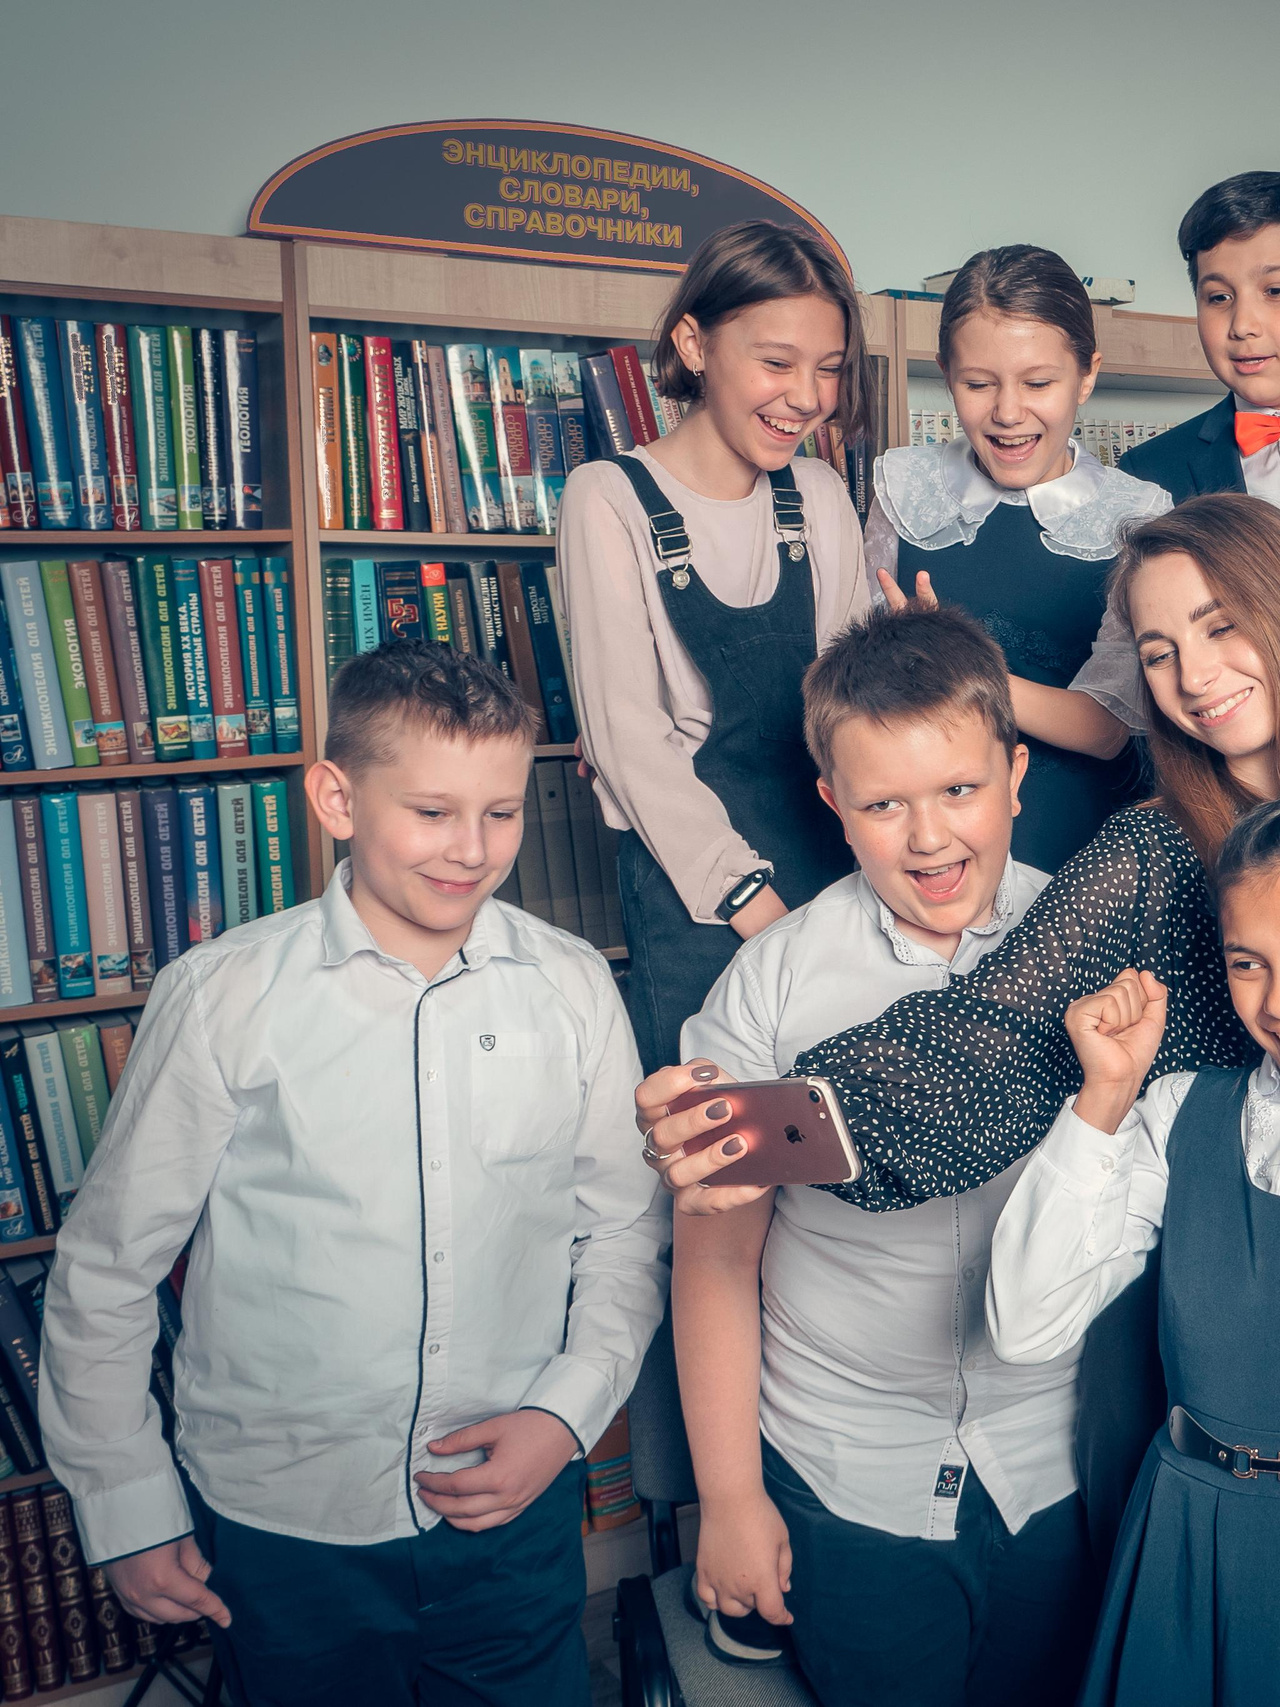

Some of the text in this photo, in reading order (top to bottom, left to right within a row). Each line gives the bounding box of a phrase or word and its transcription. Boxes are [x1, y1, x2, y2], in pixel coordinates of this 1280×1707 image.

[441, 138, 699, 198] ЭНЦИКЛОПЕДИИ,
[498, 176, 650, 219] СЛОВАРИ,
[462, 203, 683, 249] СПРАВОЧНИКИ
[150, 334, 169, 481] ЭНЦИКЛОПЕДИЯ ДЛЯ ДЕТЕЙ
[183, 384, 197, 454] ЭКОЛОГИЯ
[238, 387, 251, 453] ГЕОЛОГИЯ
[393, 356, 409, 430] МИР ЖИВОТНЫХ
[374, 364, 396, 501] ВЕТЕРИНАРИЯ
[243, 589, 253, 614] ДЕТЕЙ
[247, 616, 255, 632] ДЛЯ
[273, 588, 283, 612] ДЕТЕЙ
[276, 615, 285, 631] ДЛЯ
[361, 584, 373, 621] ИМЁН
[432, 592, 448, 631] НАУКИ
[480, 577, 497, 651] ЭНЦИКЛОПЕДИЯ
[489, 577, 503, 637] ФАНТАСТИКИ
[16, 577, 57, 755] ЭНЦИКЛОПЕДИЯ ДЛЯ ДЕТЕЙ
[64, 618, 86, 689] ЭКОЛОГИЯ
[79, 569, 112, 716] ЭНЦИКЛОПЕДИЯ ДЛЯ ДЕТЕЙ
[118, 569, 149, 716] ЭНЦИКЛОПЕДИЯ ДЛЯ ДЕТЕЙ
[153, 564, 178, 710] ЭНЦИКЛОПЕДИЯ ДЛЯ ДЕТЕЙ
[188, 593, 209, 708] ЗАРУБЕЖНЫЕ СТРАНЫ
[210, 566, 234, 709] ЭНЦИКЛОПЕДИЯ ДЛЯ ДЕТЕЙ
[248, 635, 260, 697] ЭНЦИКЛОПЕДИЯ
[278, 633, 290, 695] ЭНЦИКЛОПЕДИЯ
[182, 652, 196, 700] ИСТОРИЯ
[190, 797, 206, 836] ДЕТЕЙ
[231, 798, 245, 834] ДЕТЕЙ
[263, 795, 278, 832] ДЕТЕЙ
[22, 806, 47, 953] ЭНЦИКЛОПЕДИЯ ДЛЯ ДЕТЕЙ
[61, 838, 71, 859] ДЛЯ
[94, 802, 117, 947] ЭНЦИКЛОПЕДИЯ ДЛЯ ДЕТЕЙ
[120, 801, 144, 944] ЭНЦИКЛОПЕДИЯ ДЛЯ ДЕТЕЙ
[195, 841, 208, 866] ДЛЯ
[235, 840, 247, 863] ДЛЯ
[268, 837, 280, 861] ДЛЯ
[63, 863, 79, 947] ЭНЦИКЛОПЕДИЯ
[154, 803, 179, 961] ЦИКЛОПЕДИЯ ДЛЯ ДЕТЕЙ
[73, 1036, 88, 1067] ДЕТЕЙ
[81, 1071, 93, 1091] ДЛЯ
[37, 1042, 74, 1183] ЭНЦИКЛОПЕДИЯ ДЛЯ ДЕТЕЙ
